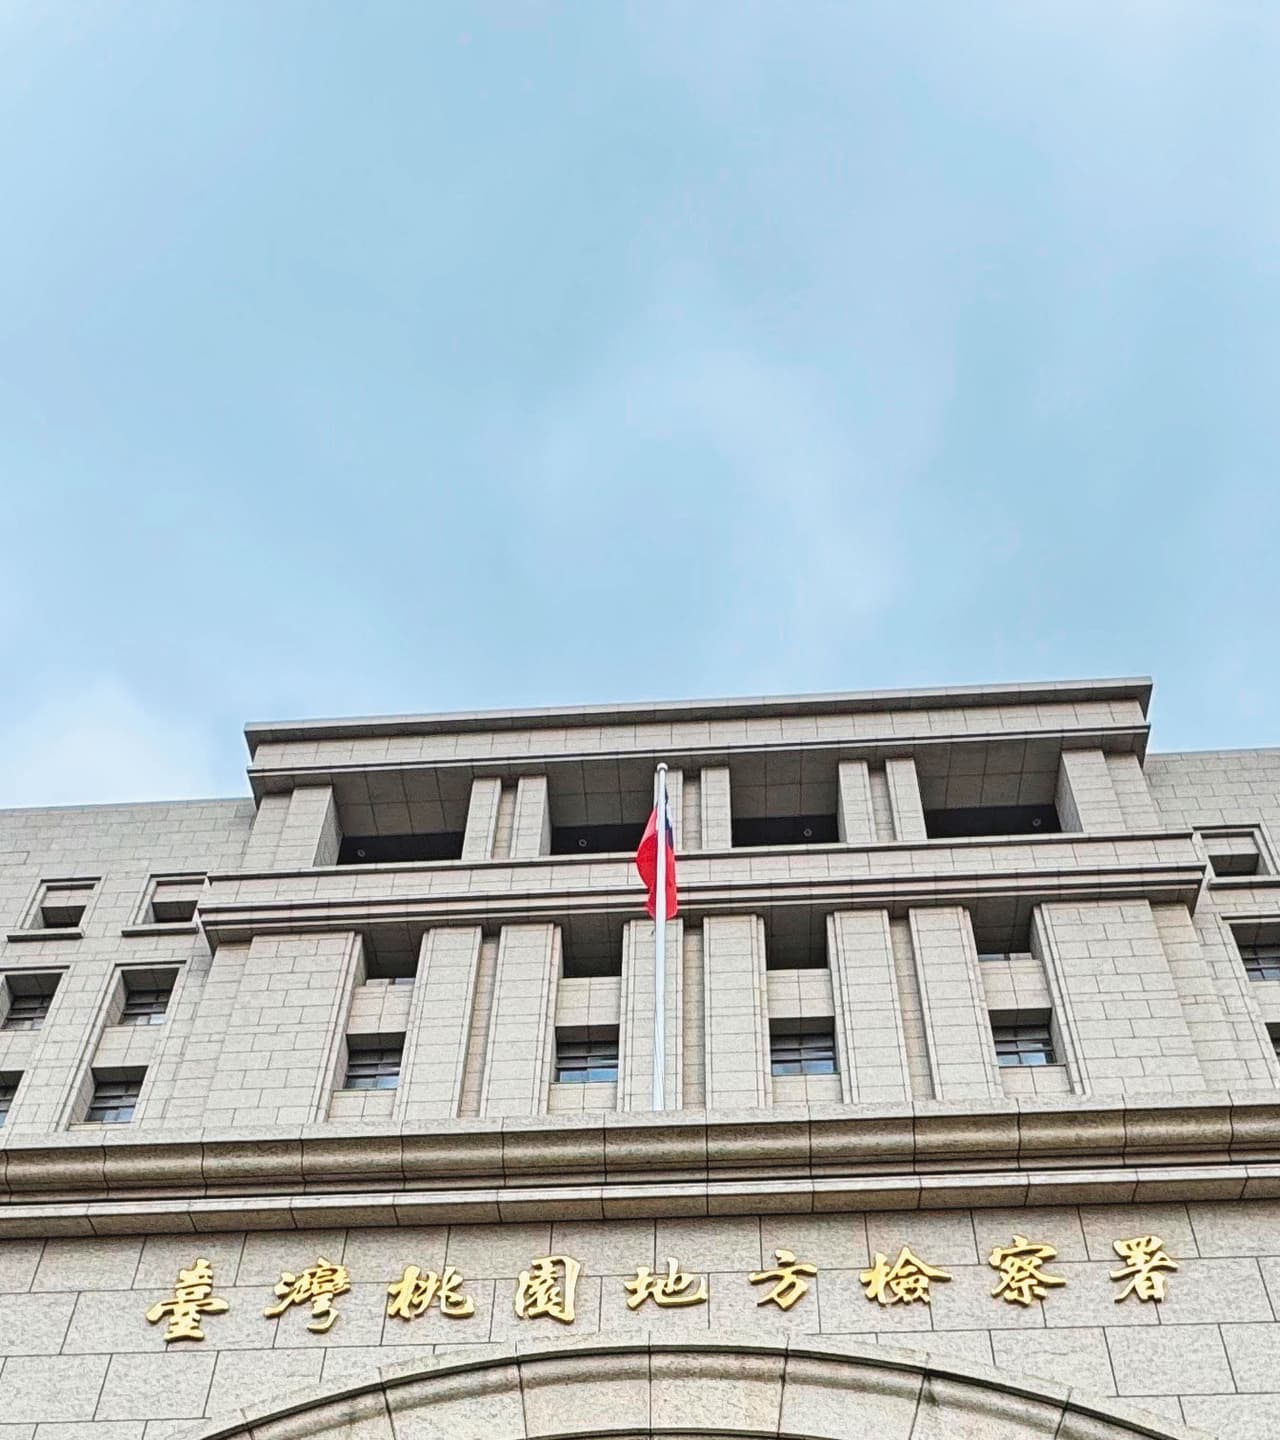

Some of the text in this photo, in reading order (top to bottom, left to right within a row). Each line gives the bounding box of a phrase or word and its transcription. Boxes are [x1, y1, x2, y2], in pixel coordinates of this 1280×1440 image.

[146, 1234, 1178, 1343] 臺灣桃園地方檢察署
